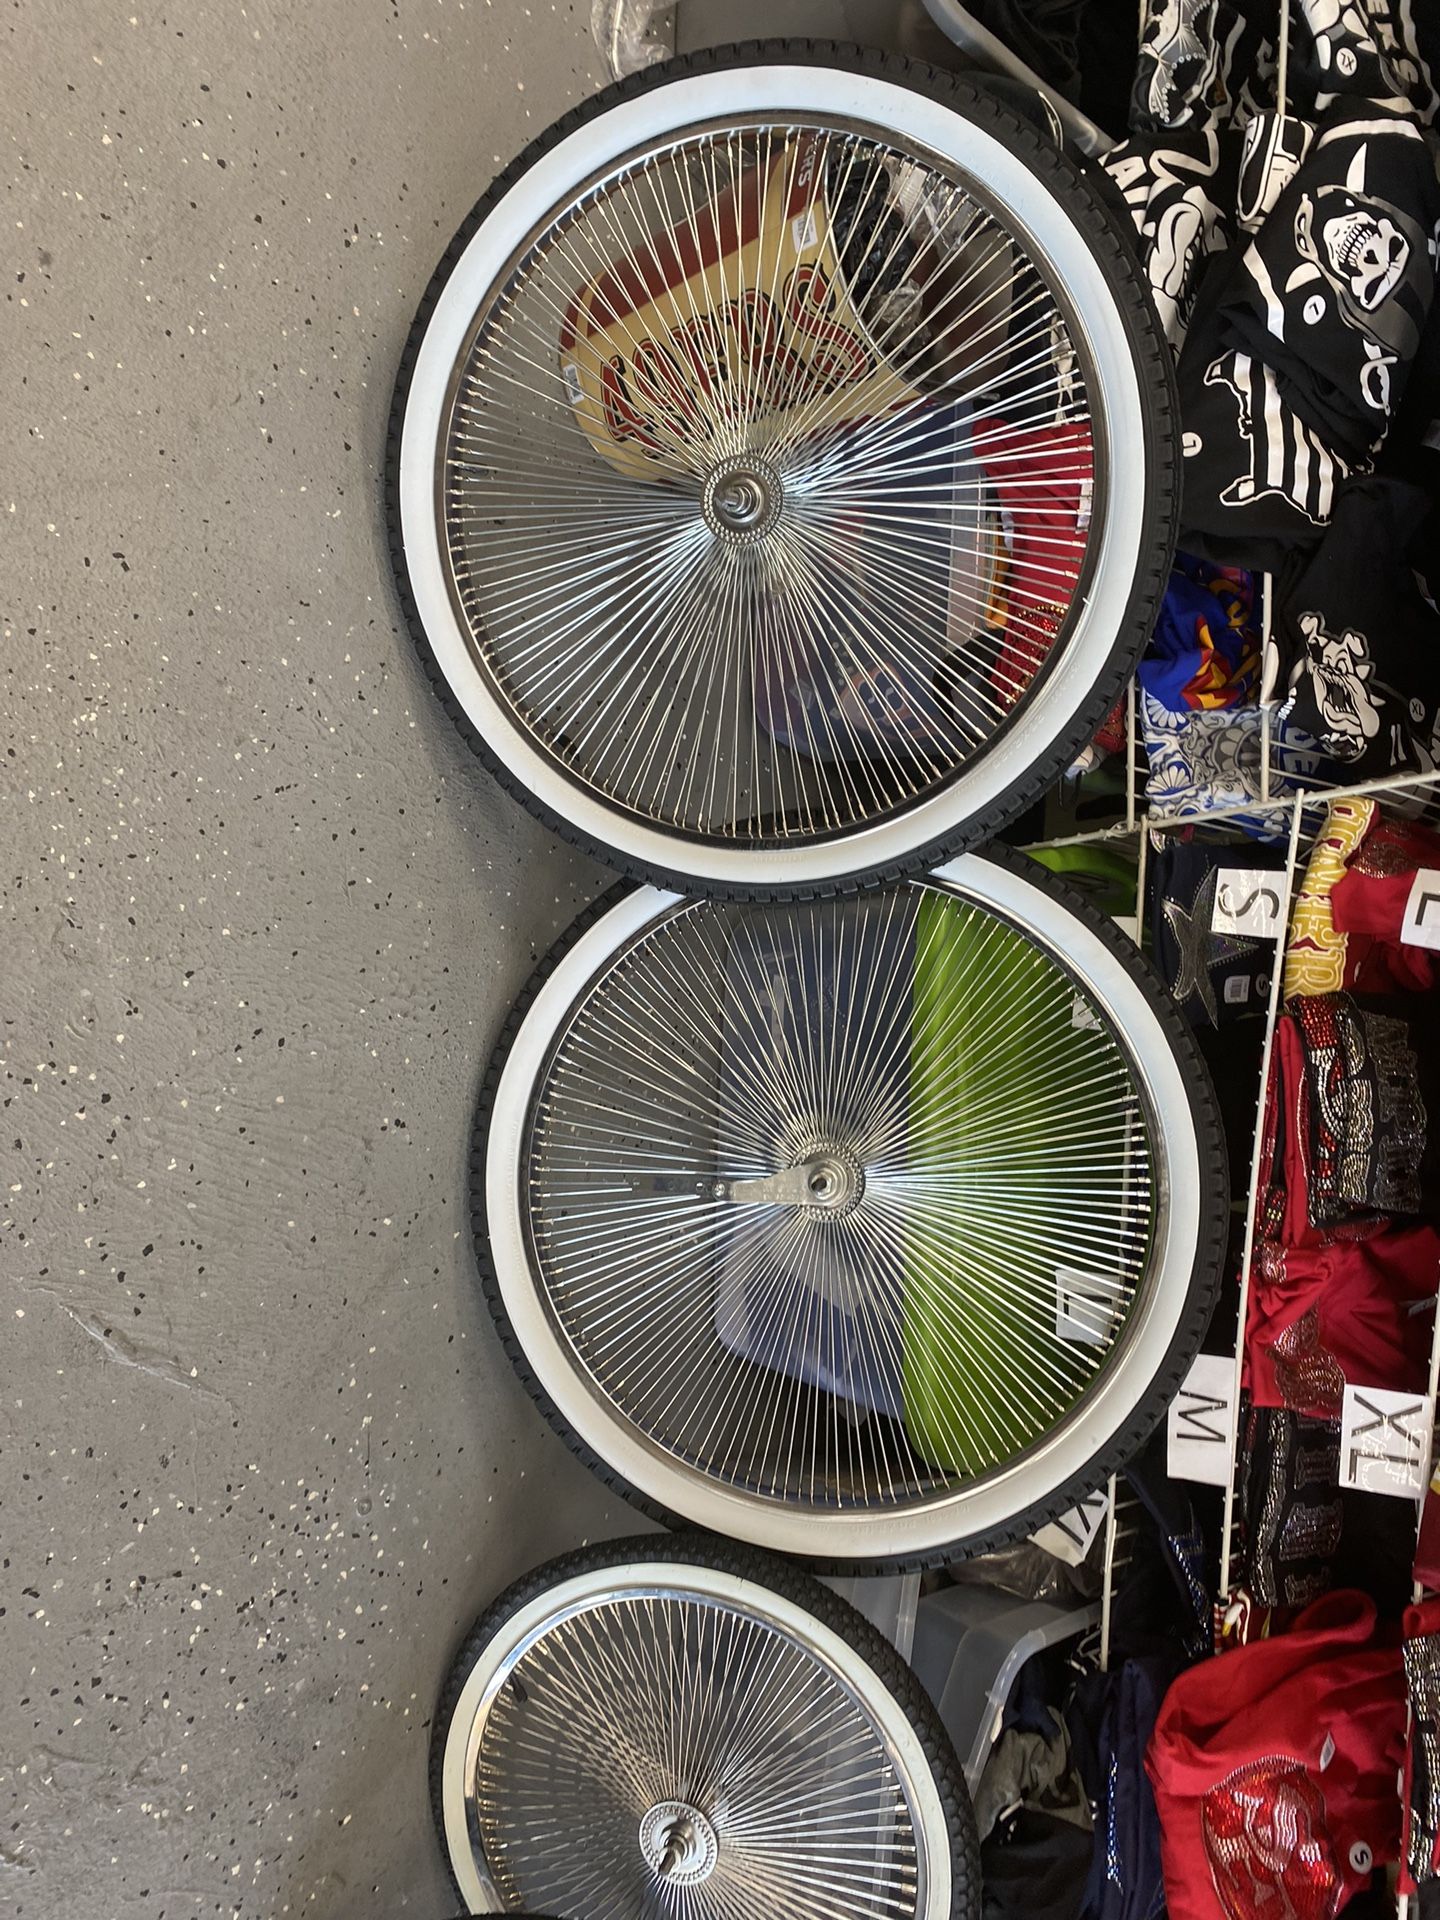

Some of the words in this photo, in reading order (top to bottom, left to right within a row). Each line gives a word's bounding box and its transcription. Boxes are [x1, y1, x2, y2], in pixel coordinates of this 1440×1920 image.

[1309, 303, 1320, 316] L
[1412, 702, 1423, 717] XL
[1218, 884, 1280, 919] S
[1415, 892, 1440, 926] L
[1063, 1292, 1112, 1319] L
[1177, 1390, 1227, 1442] M
[1349, 1392, 1423, 1483] XL
[1354, 1850, 1369, 1866] S
